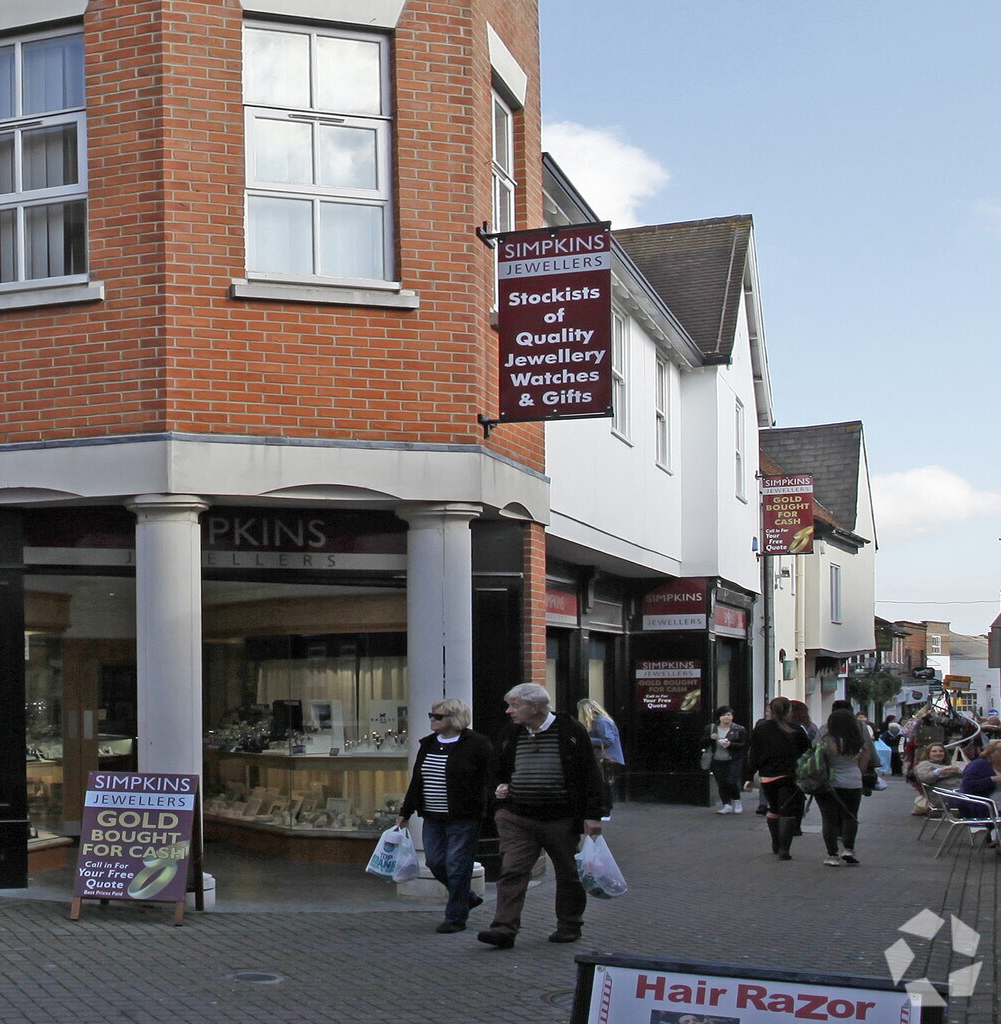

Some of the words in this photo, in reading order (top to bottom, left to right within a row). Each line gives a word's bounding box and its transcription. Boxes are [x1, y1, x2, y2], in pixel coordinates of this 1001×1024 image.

[504, 234, 605, 259] SIMPKINS
[506, 255, 603, 276] JEWELLERS
[508, 286, 600, 307] Stockists
[543, 307, 565, 324] of
[515, 328, 594, 347] Quality
[504, 348, 606, 368] Jewellery
[510, 369, 600, 387] Watches
[518, 393, 535, 407] &
[542, 389, 593, 406] Gifts
[765, 478, 811, 487] SIMPKINS
[766, 486, 810, 494] JEWELLERS
[766, 503, 810, 511] BOUGHT
[773, 496, 803, 504] GOLD
[774, 518, 801, 526] CASH
[208, 516, 327, 548] PKINS
[126, 551, 337, 567] JELLERS
[646, 592, 703, 603] SIMPKINS
[648, 618, 702, 626] JEWELLERS
[642, 661, 695, 669] SIMPKINS
[94, 775, 191, 792] SIMPKINS
[93, 794, 186, 807] JEWELLERS
[96, 810, 179, 829] GOLD
[90, 829, 182, 845] BOUGHT
[82, 843, 123, 857] FOR
[128, 845, 186, 860] CASH
[85, 860, 102, 868] Call
[78, 868, 105, 877] Your
[108, 869, 134, 879] Free
[85, 878, 124, 890] Quote
[635, 974, 727, 1006] Hair
[736, 983, 876, 1021] RaZor
